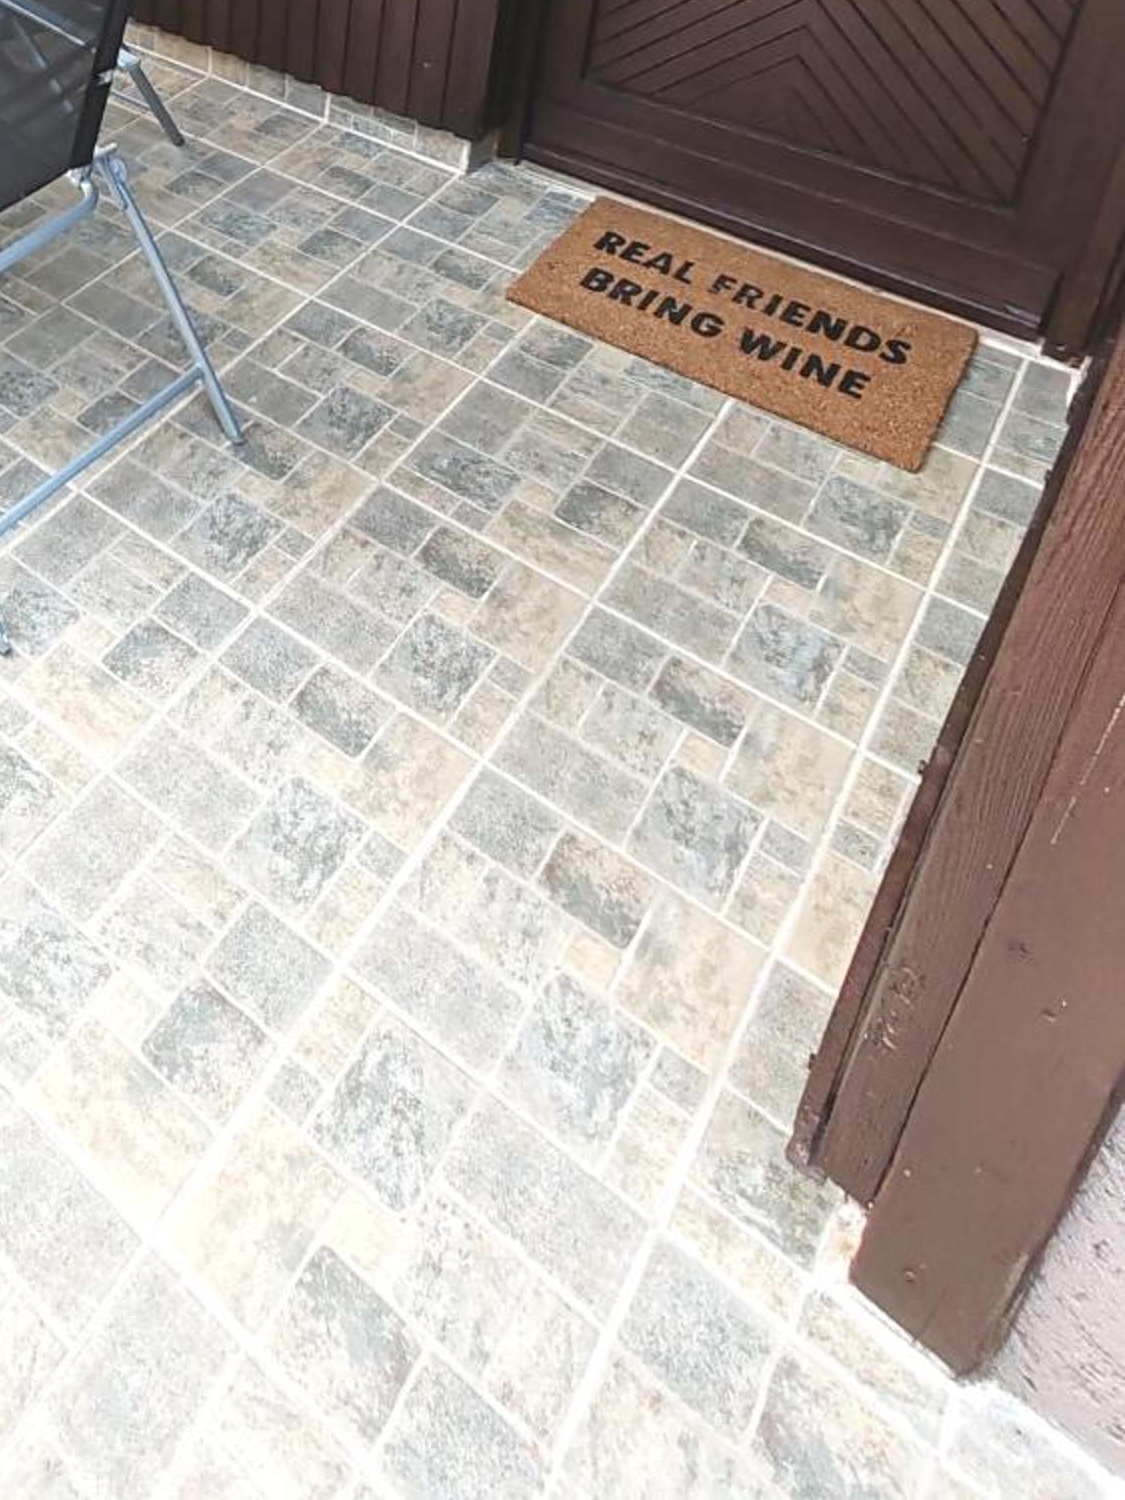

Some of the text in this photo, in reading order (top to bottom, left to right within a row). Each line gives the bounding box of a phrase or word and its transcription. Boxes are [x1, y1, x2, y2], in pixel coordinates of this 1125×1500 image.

[580, 267, 871, 399] BRING WINE
[593, 231, 912, 365] REAL FRIENDS
